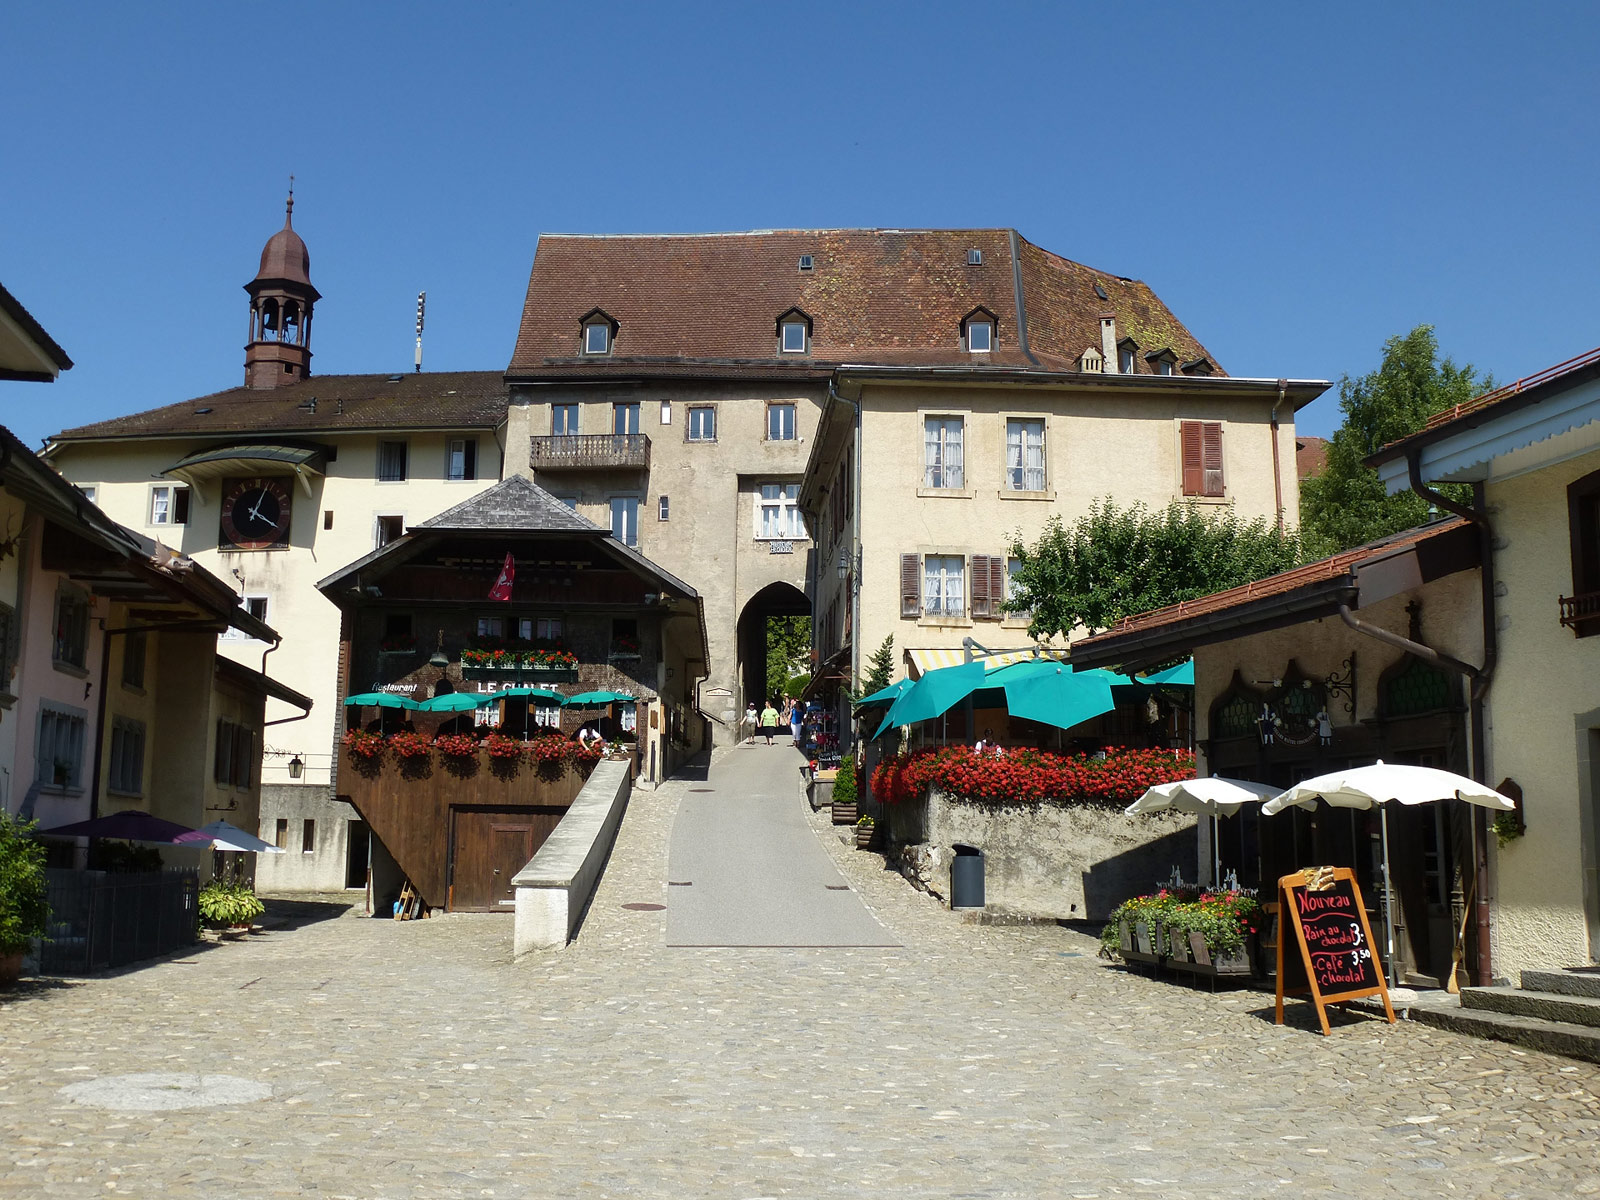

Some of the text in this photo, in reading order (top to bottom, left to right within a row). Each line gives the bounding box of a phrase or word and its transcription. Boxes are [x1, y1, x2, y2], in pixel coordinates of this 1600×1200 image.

[371, 681, 418, 693] Restaurant
[477, 682, 497, 693] LE
[1297, 890, 1350, 914] Nouveau
[1303, 924, 1340, 941] Pain au
